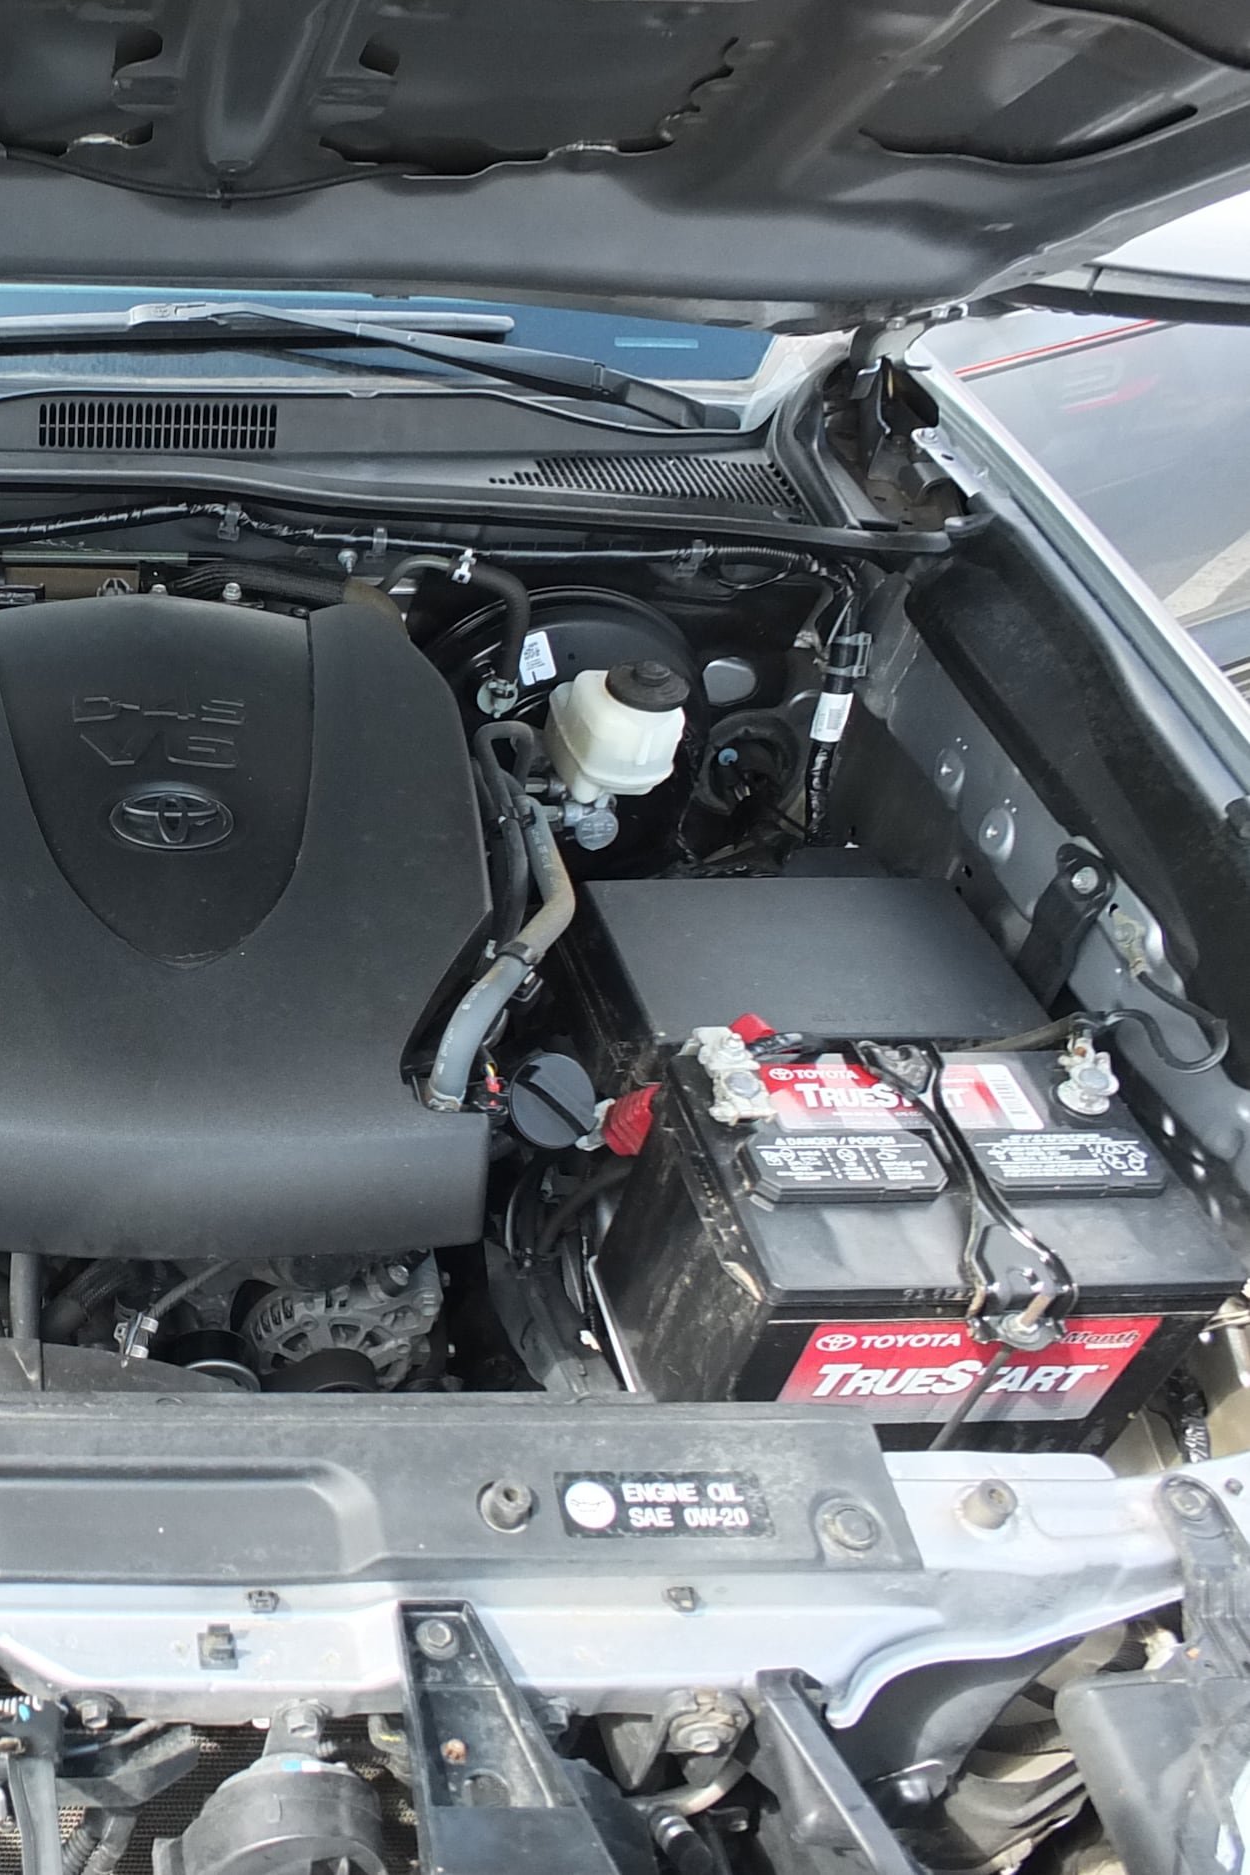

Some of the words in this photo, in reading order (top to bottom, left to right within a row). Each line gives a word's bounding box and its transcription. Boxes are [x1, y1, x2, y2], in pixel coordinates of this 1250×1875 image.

[78, 731, 240, 769] V6
[793, 1069, 861, 1081] TOYOTA
[793, 1082, 968, 1108] TRUEST
[786, 1137, 838, 1146] DANGER
[849, 1136, 896, 1145] POISON
[860, 1333, 961, 1348] TOYOTA
[621, 1481, 699, 1503] ENGINE
[706, 1481, 745, 1503] OIL
[628, 1506, 675, 1528] SAE
[682, 1506, 750, 1528] 0W-20
